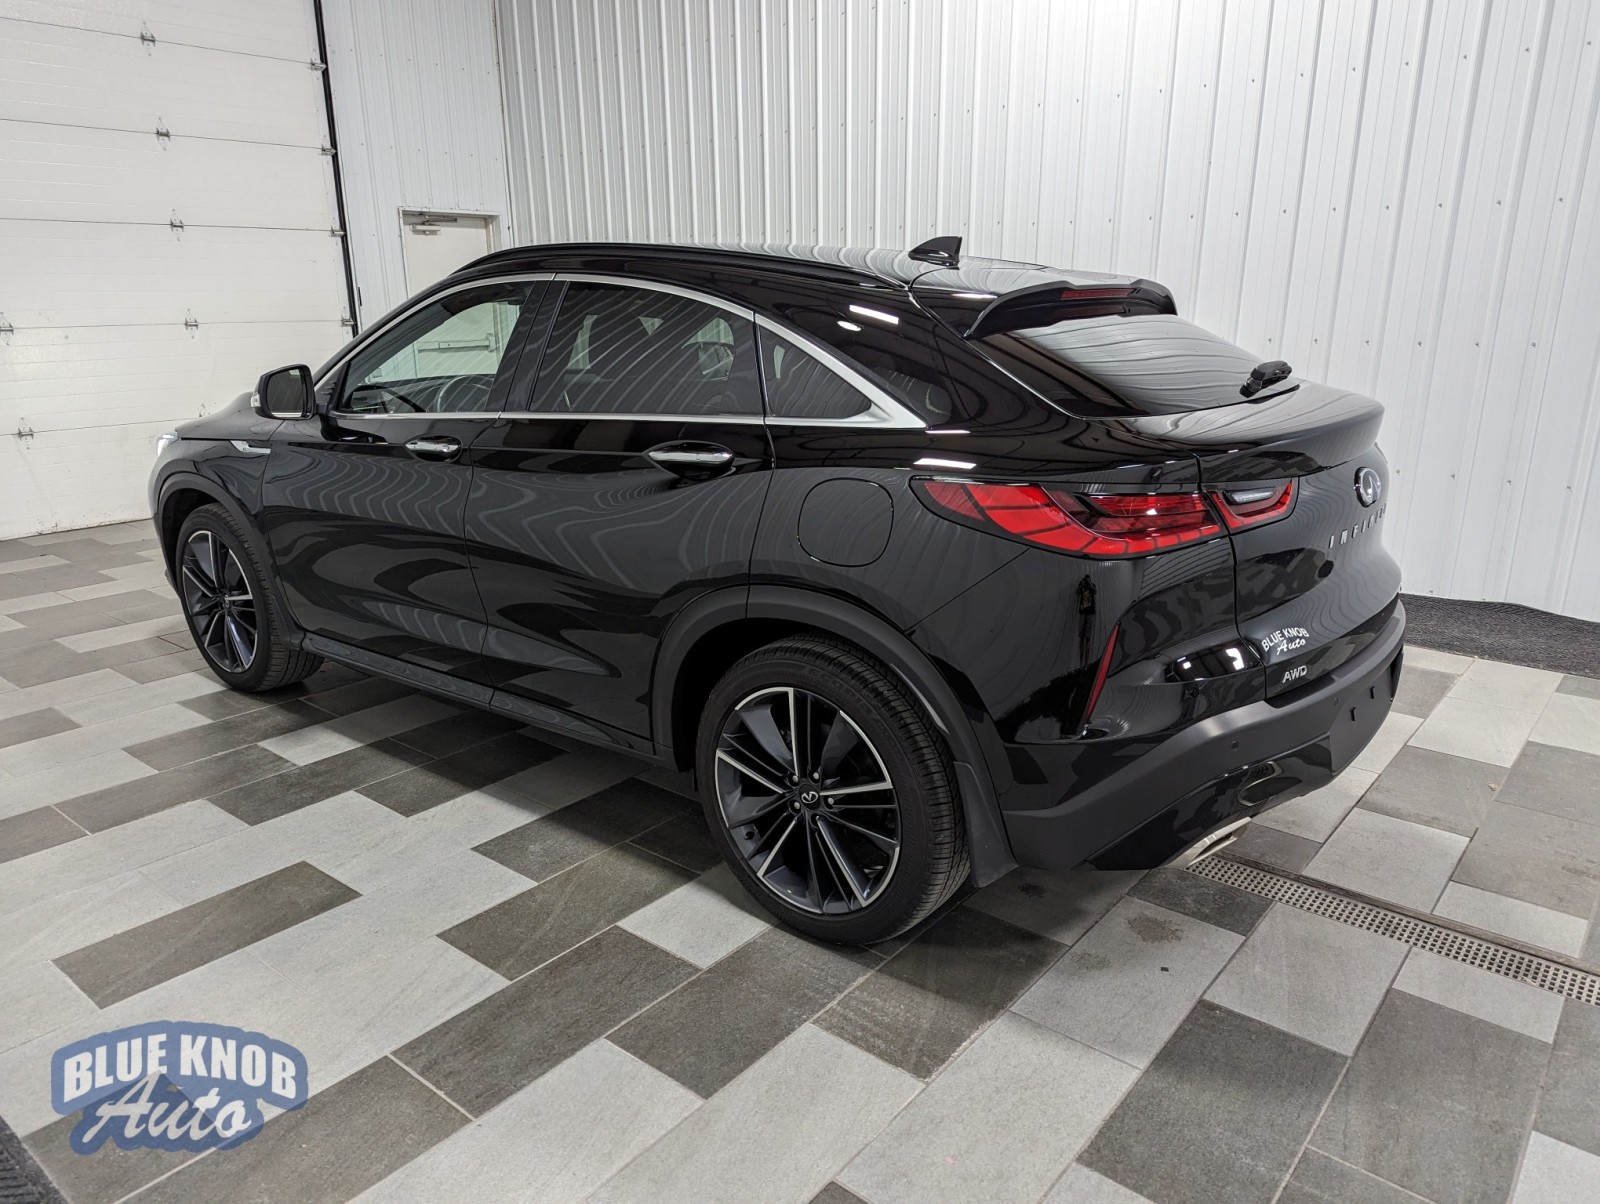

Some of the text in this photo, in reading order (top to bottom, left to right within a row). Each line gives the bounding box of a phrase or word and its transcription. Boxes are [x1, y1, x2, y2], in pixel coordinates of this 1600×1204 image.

[1261, 627, 1309, 652] BLUE KNOB
[1276, 638, 1306, 655] Auto
[1282, 665, 1307, 684] AWD
